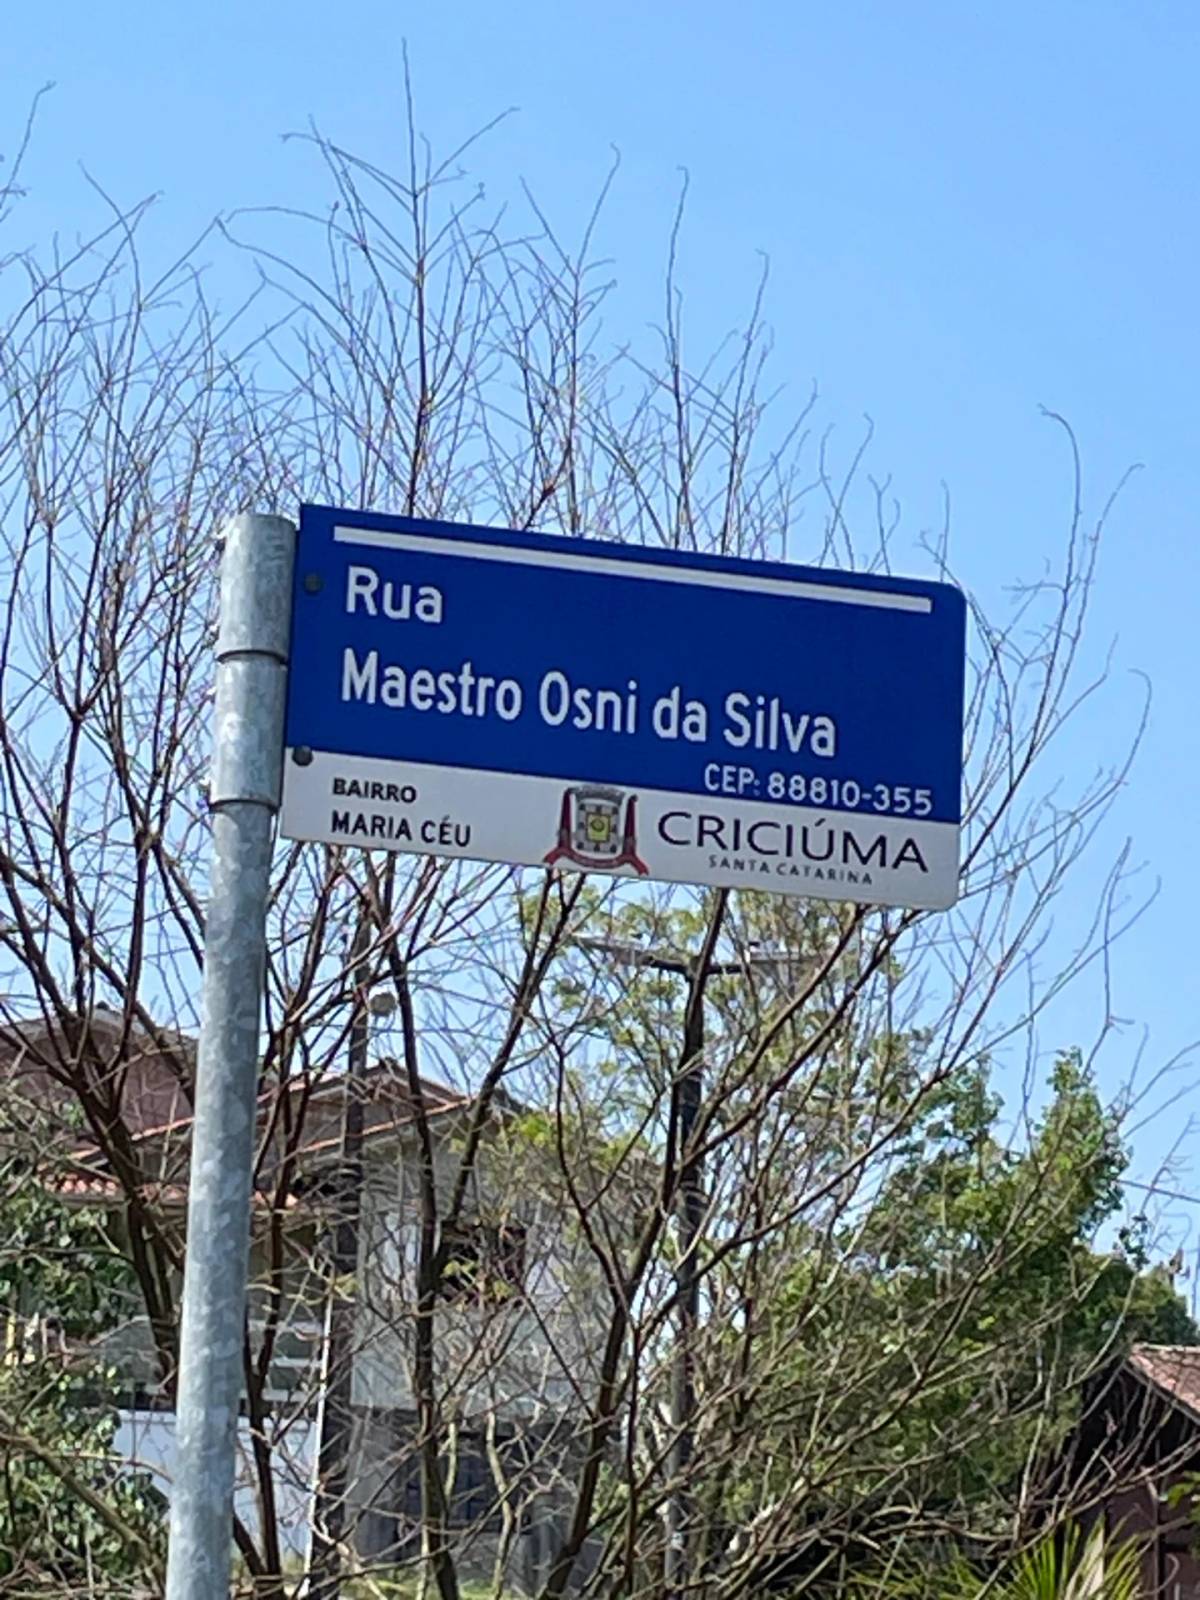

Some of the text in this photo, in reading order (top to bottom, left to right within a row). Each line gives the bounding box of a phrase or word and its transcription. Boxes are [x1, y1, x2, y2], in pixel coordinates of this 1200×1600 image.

[346, 566, 443, 624] Rua
[342, 648, 836, 758] Maestro Osni da Silva
[332, 777, 417, 804] BAIRRO
[704, 763, 933, 816] CEP: 88810-355
[331, 810, 471, 848] MARIA CÉU
[658, 811, 929, 873] CRICIÚMA
[708, 854, 873, 886] SANTA CATARINA
